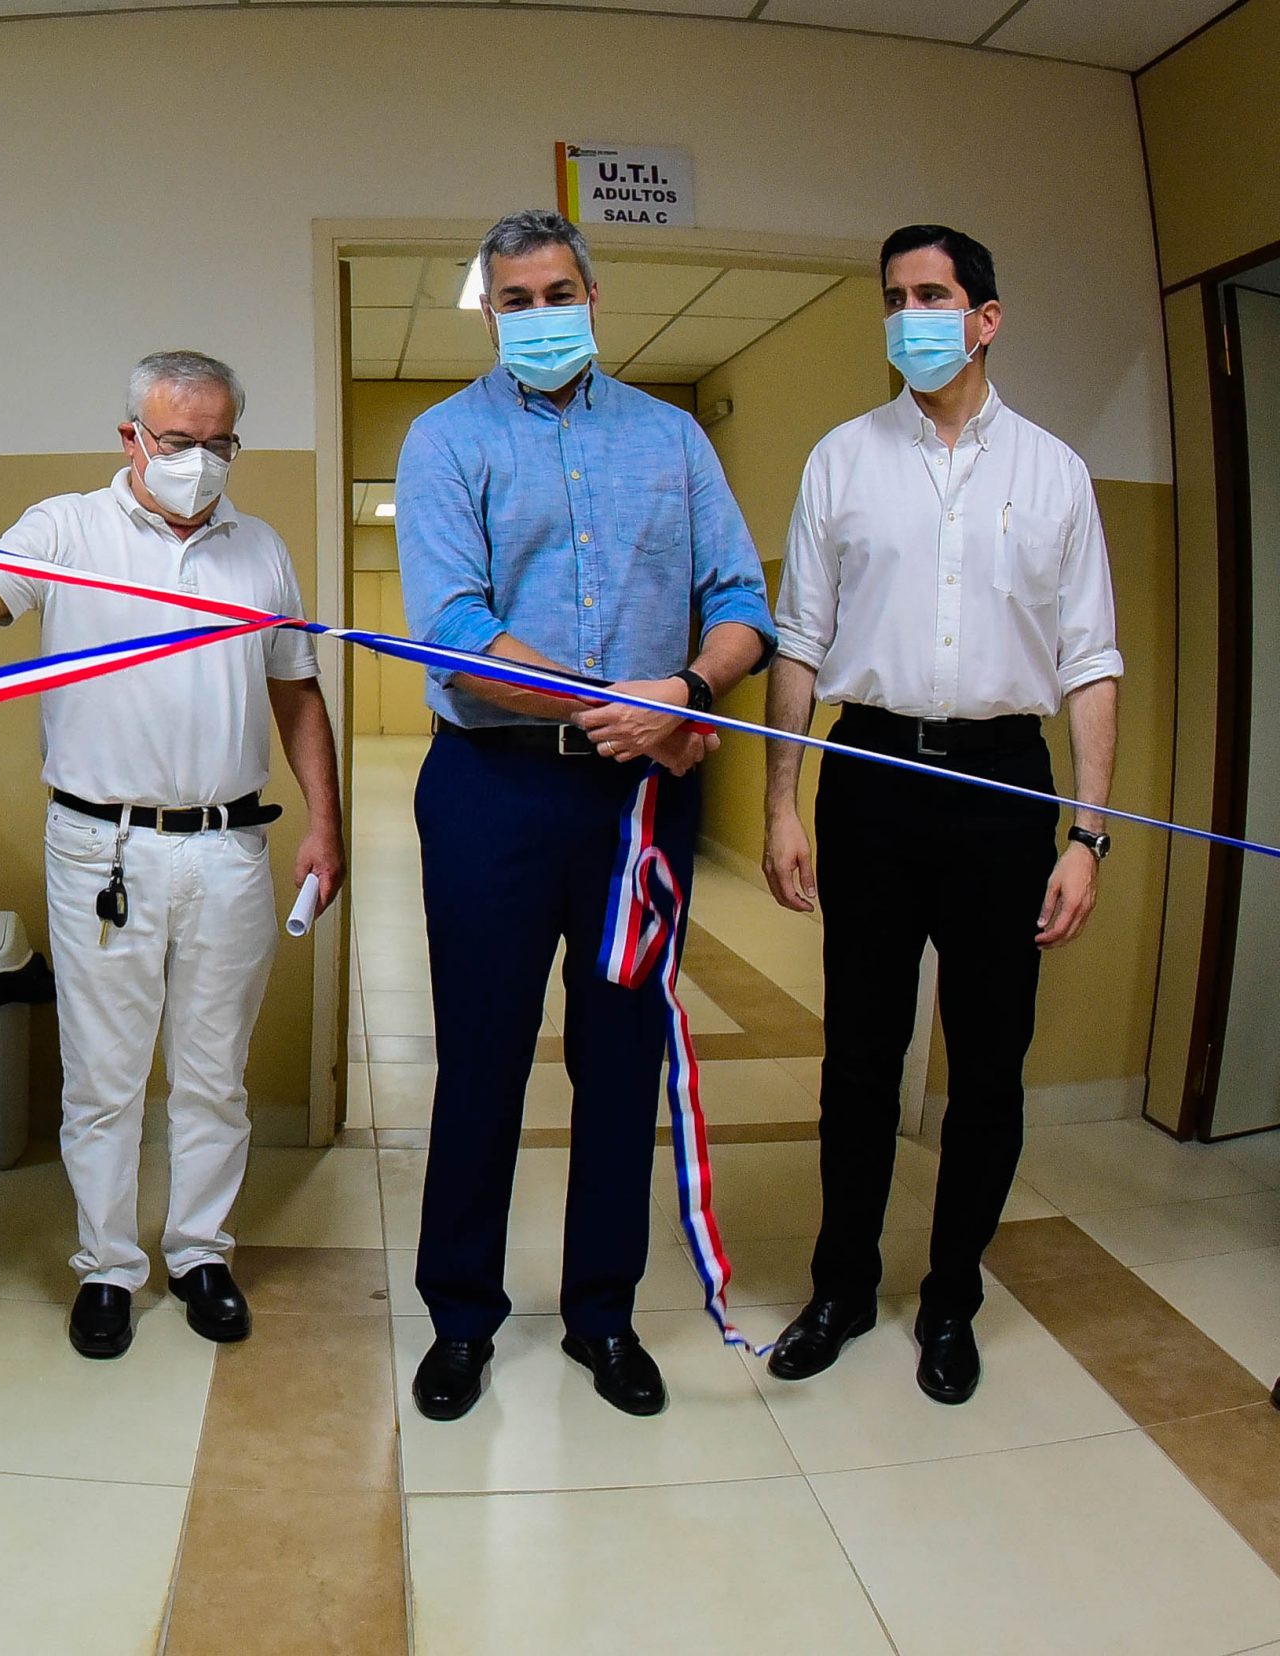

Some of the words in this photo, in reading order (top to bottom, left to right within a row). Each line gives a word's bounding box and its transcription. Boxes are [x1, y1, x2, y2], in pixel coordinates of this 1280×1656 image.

[598, 162, 668, 185] U.T.I.
[592, 187, 677, 204] ADULTOS
[604, 209, 651, 223] SALA
[655, 211, 668, 224] C
